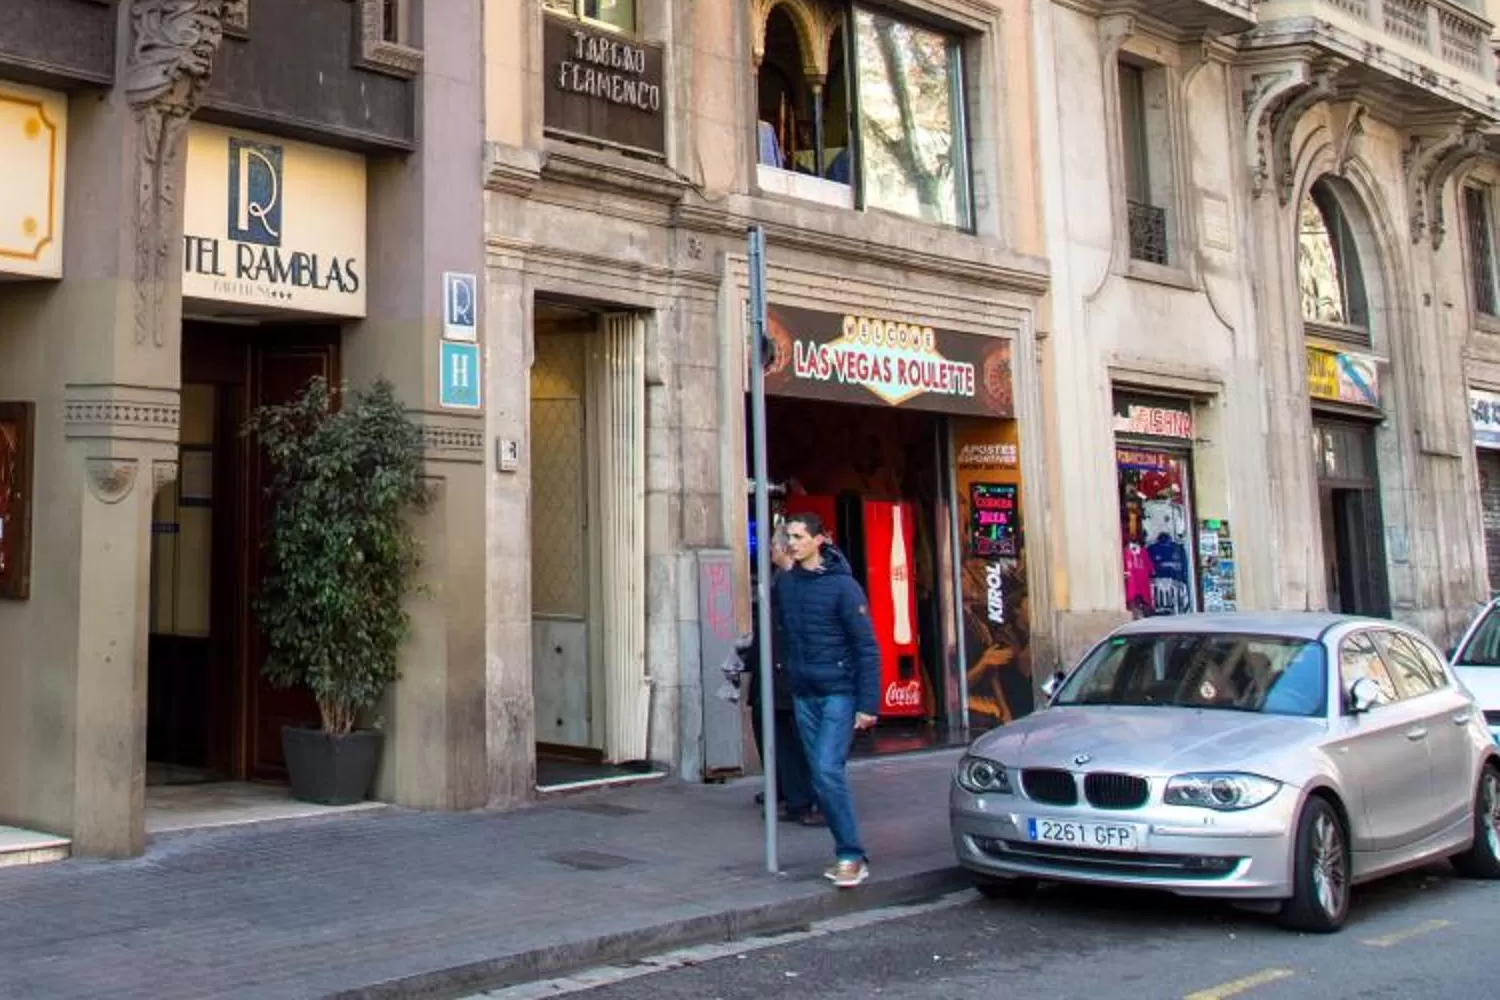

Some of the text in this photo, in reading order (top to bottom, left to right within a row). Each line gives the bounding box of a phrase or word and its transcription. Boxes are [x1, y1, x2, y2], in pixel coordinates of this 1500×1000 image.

[560, 61, 660, 111] FLAMENCO
[184, 235, 226, 276] TEL
[236, 243, 359, 294] RAMBLAS
[844, 321, 933, 349] WELCOME
[451, 353, 469, 387] H
[796, 341, 974, 394] LAS VEGAS ROULETTE
[985, 563, 1004, 624] KIROL
[1042, 821, 1129, 845] 2261 GFP
